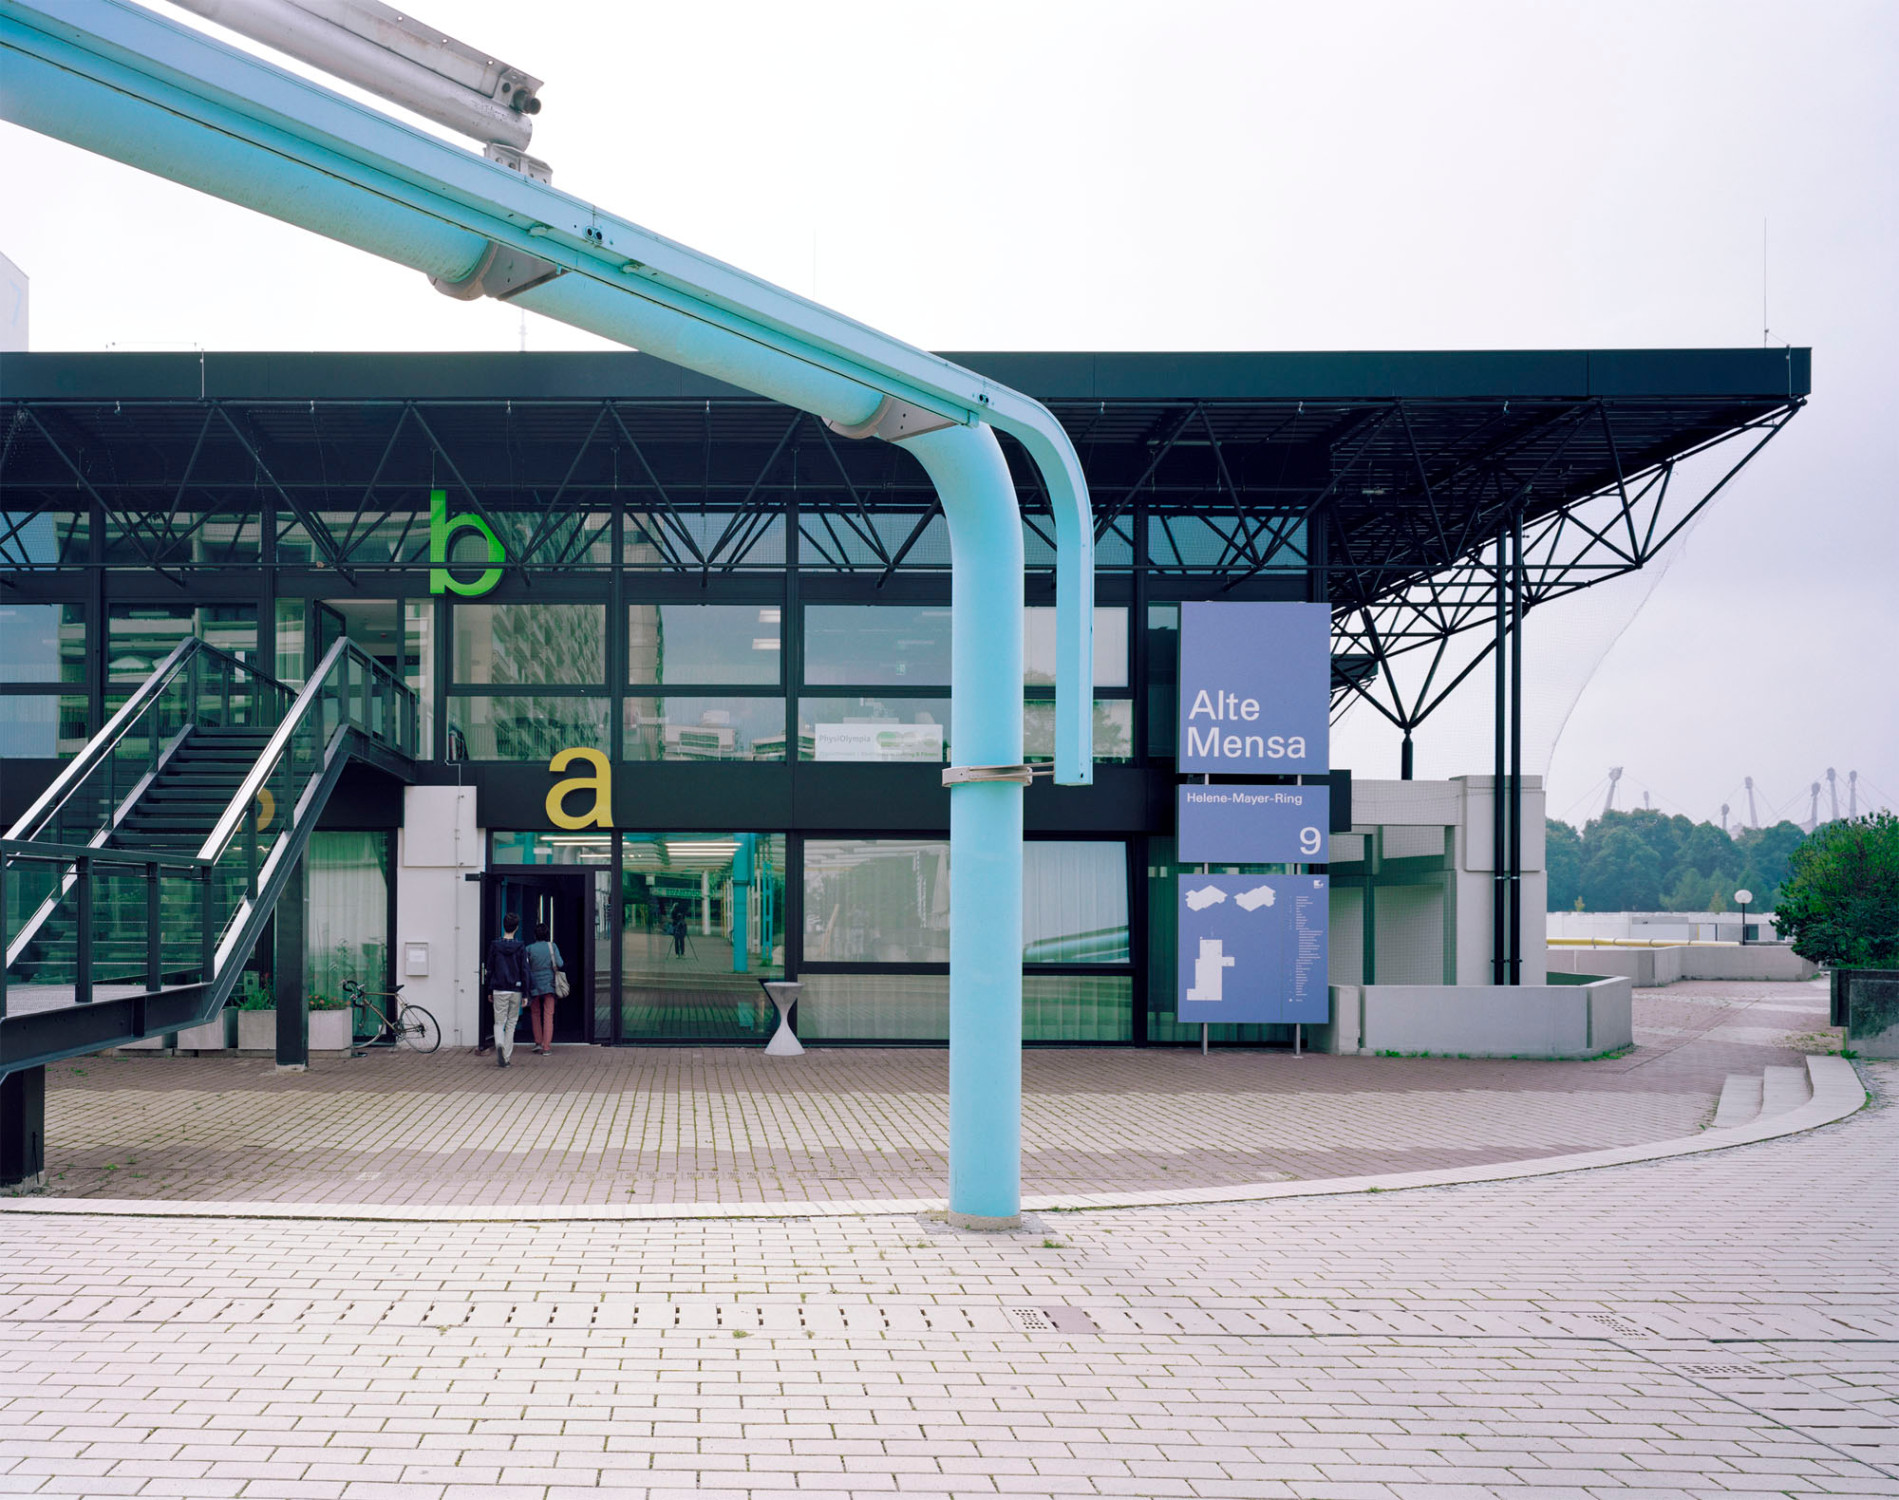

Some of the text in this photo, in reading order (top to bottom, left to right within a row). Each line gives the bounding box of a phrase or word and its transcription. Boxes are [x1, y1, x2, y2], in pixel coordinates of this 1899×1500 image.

[429, 489, 506, 597] b
[1188, 690, 1260, 721] Alte
[1187, 726, 1306, 759] Mensa
[545, 746, 614, 830] a
[1186, 792, 1303, 806] Helene-Mayer-Ring
[1299, 826, 1322, 855] 9
